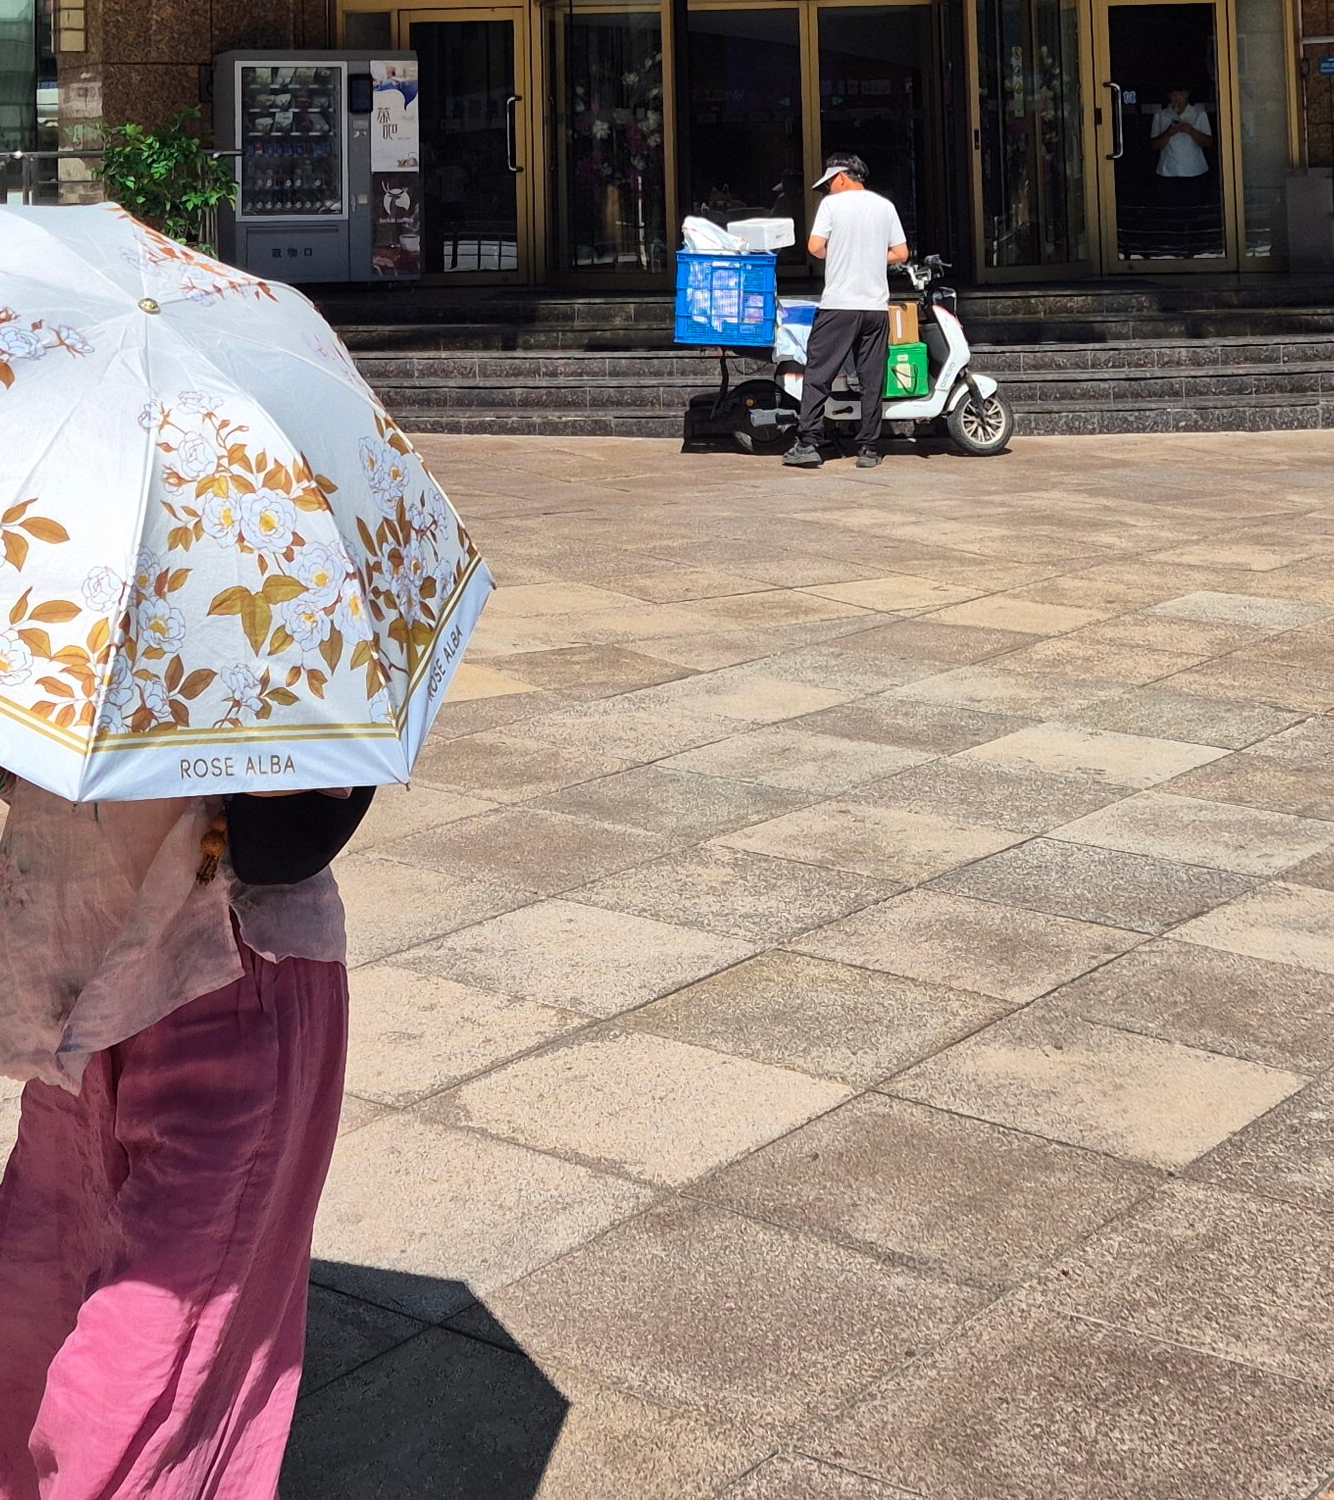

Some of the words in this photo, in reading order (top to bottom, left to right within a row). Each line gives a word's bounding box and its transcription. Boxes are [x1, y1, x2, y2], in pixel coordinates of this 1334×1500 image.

[272, 247, 313, 258] 取物口
[443, 624, 463, 664] ALBA
[180, 756, 235, 780] ROSE
[246, 754, 296, 775] ALBA
